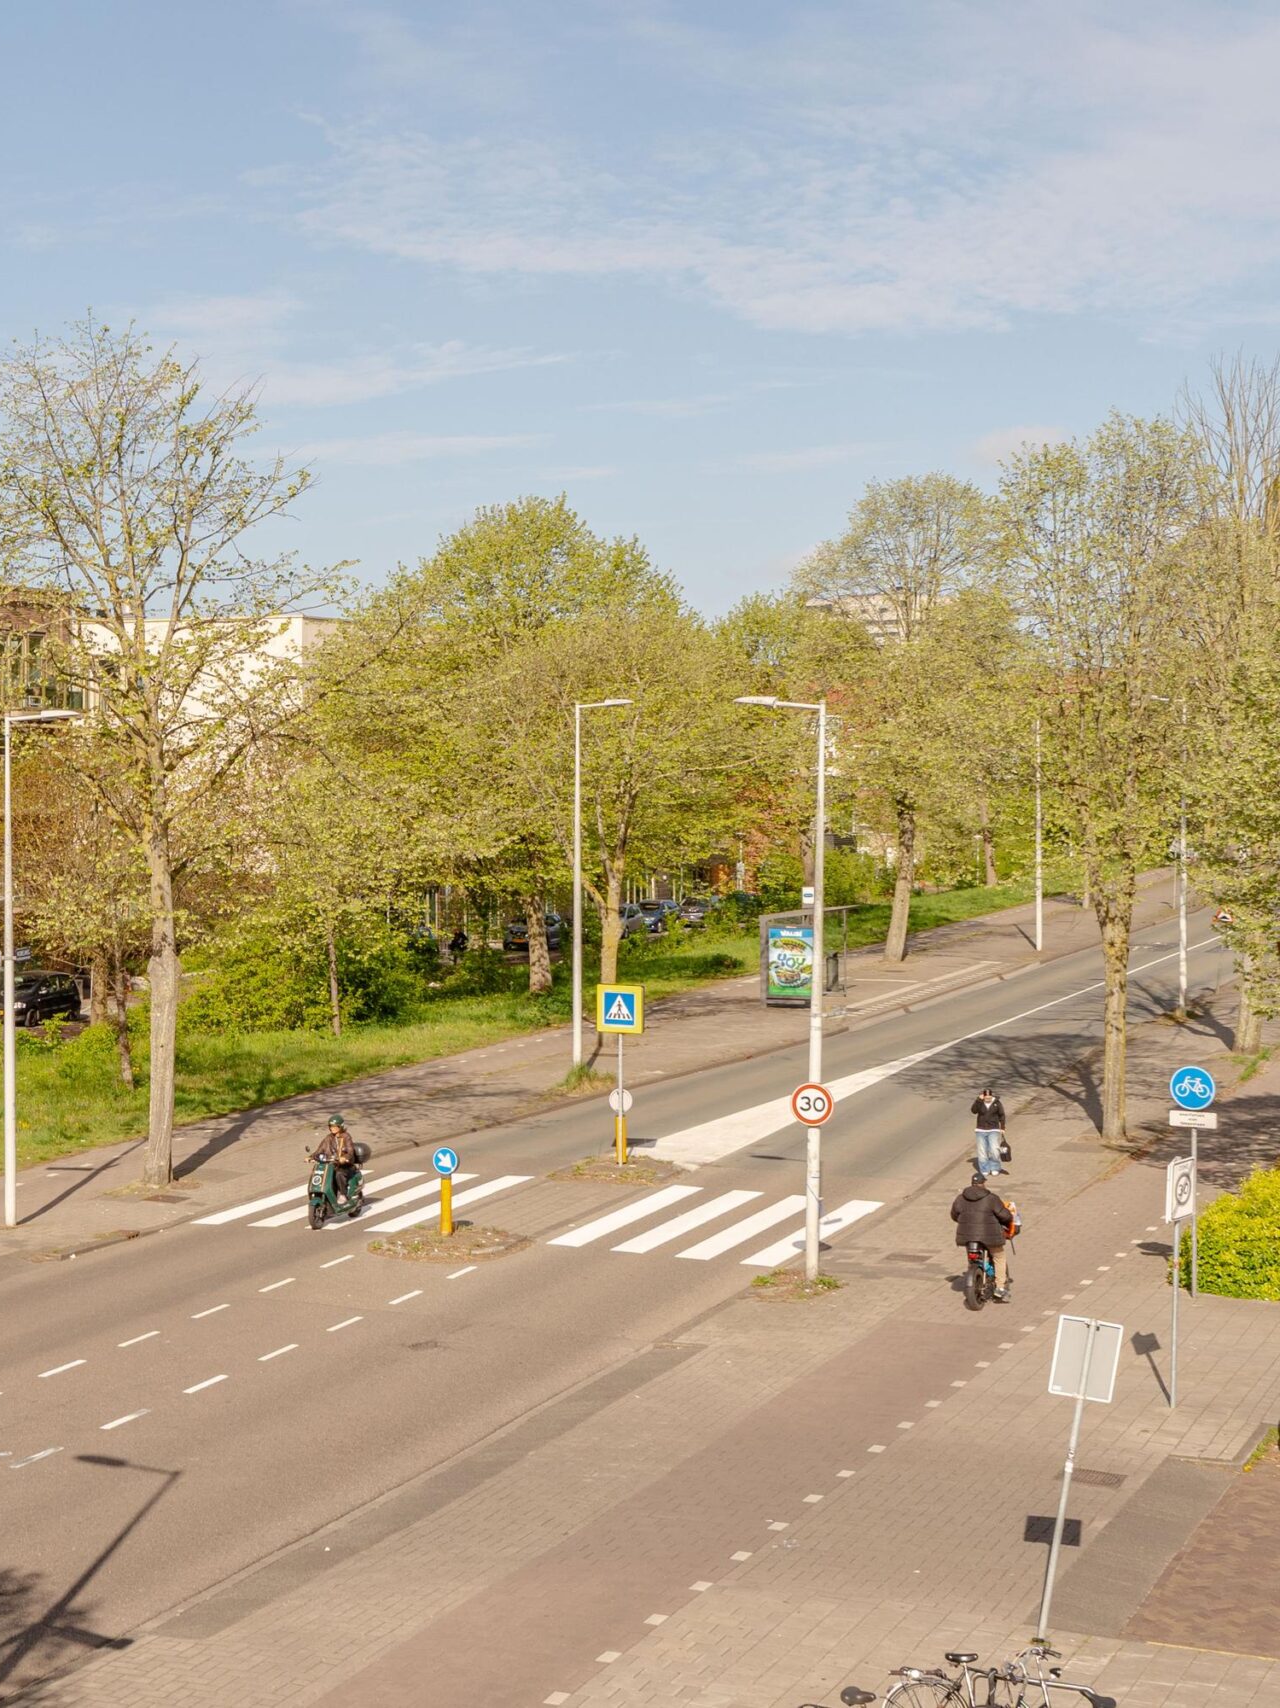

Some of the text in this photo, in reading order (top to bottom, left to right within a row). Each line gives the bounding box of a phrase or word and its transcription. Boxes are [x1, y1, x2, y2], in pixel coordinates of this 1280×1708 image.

[777, 953, 806, 970] YOY
[800, 1096, 825, 1112] 30
[1178, 1182, 1189, 1197] 30
